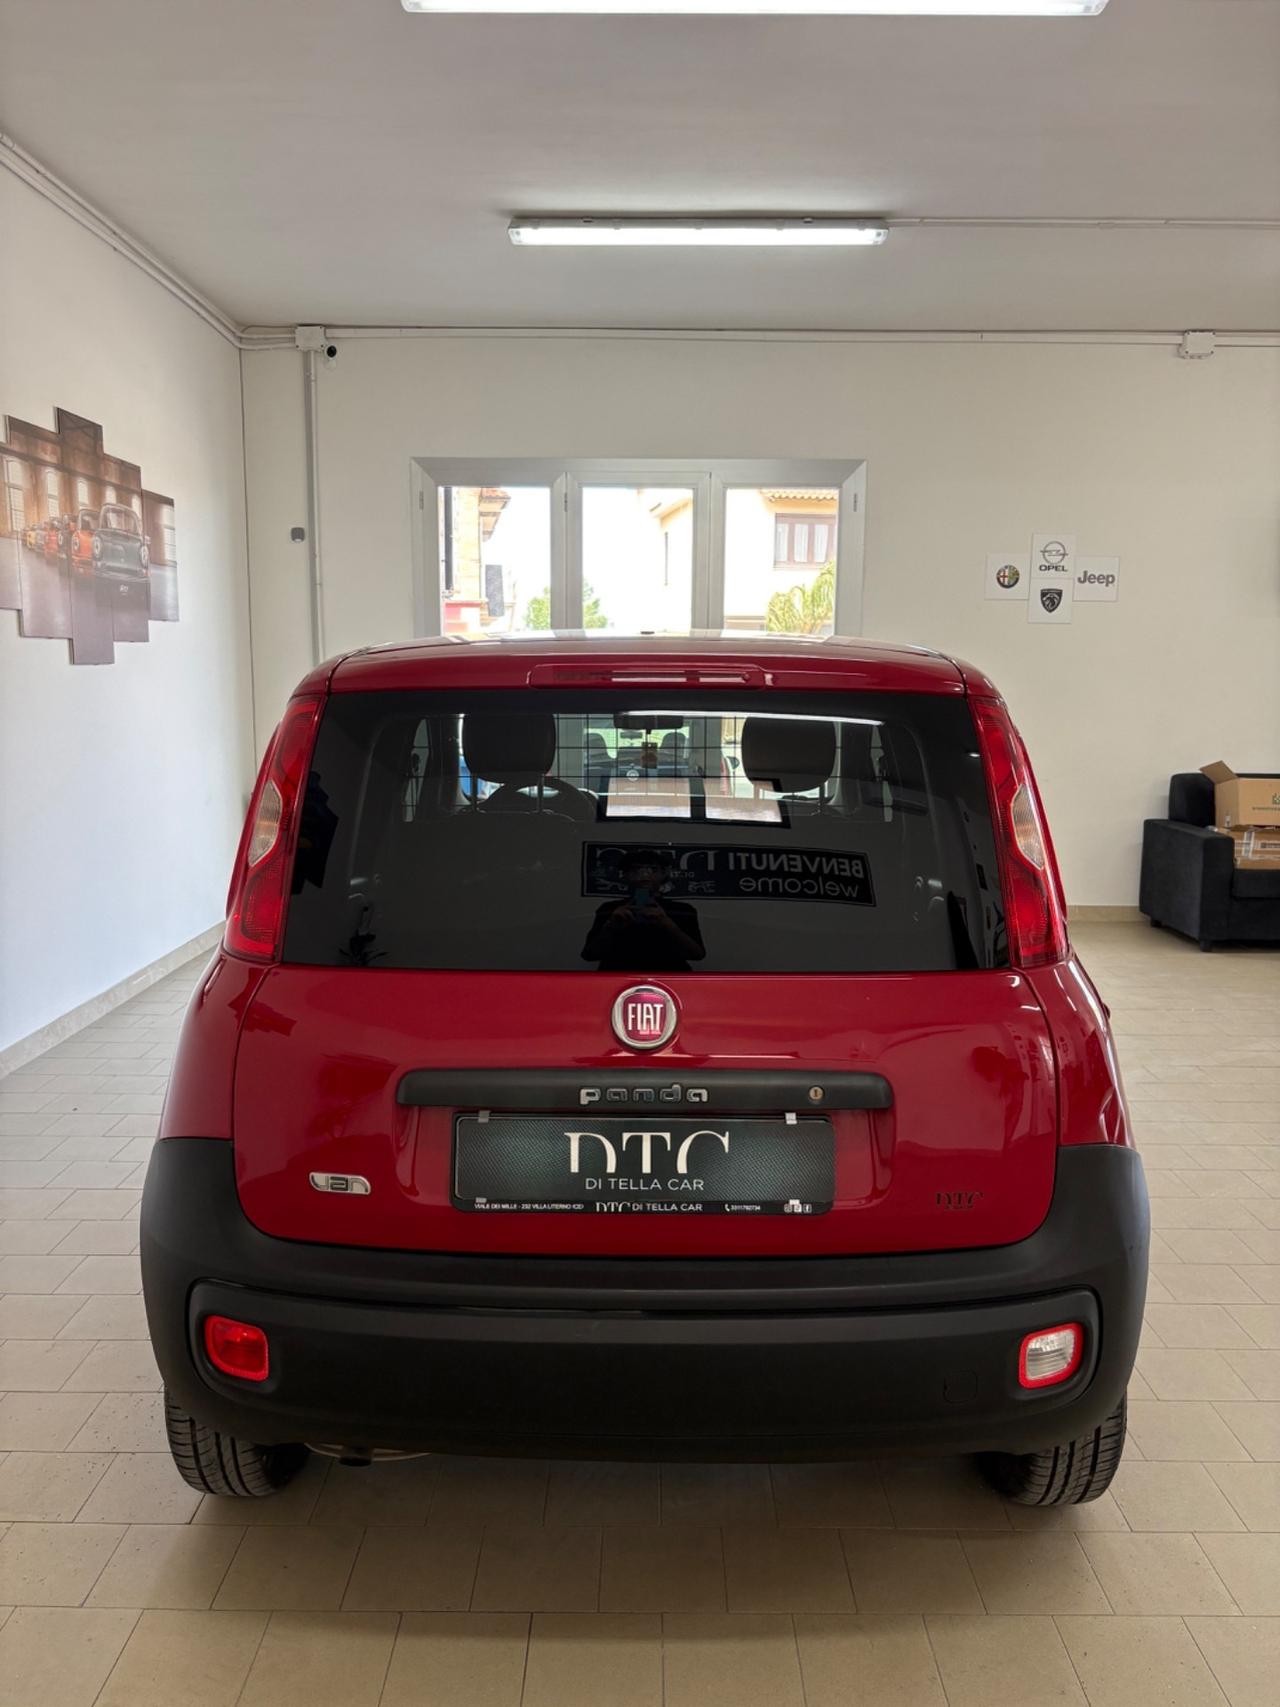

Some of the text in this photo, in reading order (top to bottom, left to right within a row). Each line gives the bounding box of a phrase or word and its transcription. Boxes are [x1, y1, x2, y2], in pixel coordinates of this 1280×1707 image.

[1039, 564, 1068, 572] OPEL
[1077, 570, 1115, 587] Jeep
[627, 1003, 664, 1032] FIAT
[579, 1084, 709, 1105] panda
[564, 1130, 729, 1174] DTC
[586, 1178, 705, 1191] DI TELLA CAR
[596, 1202, 703, 1212] DTC DI TELLA CAR
